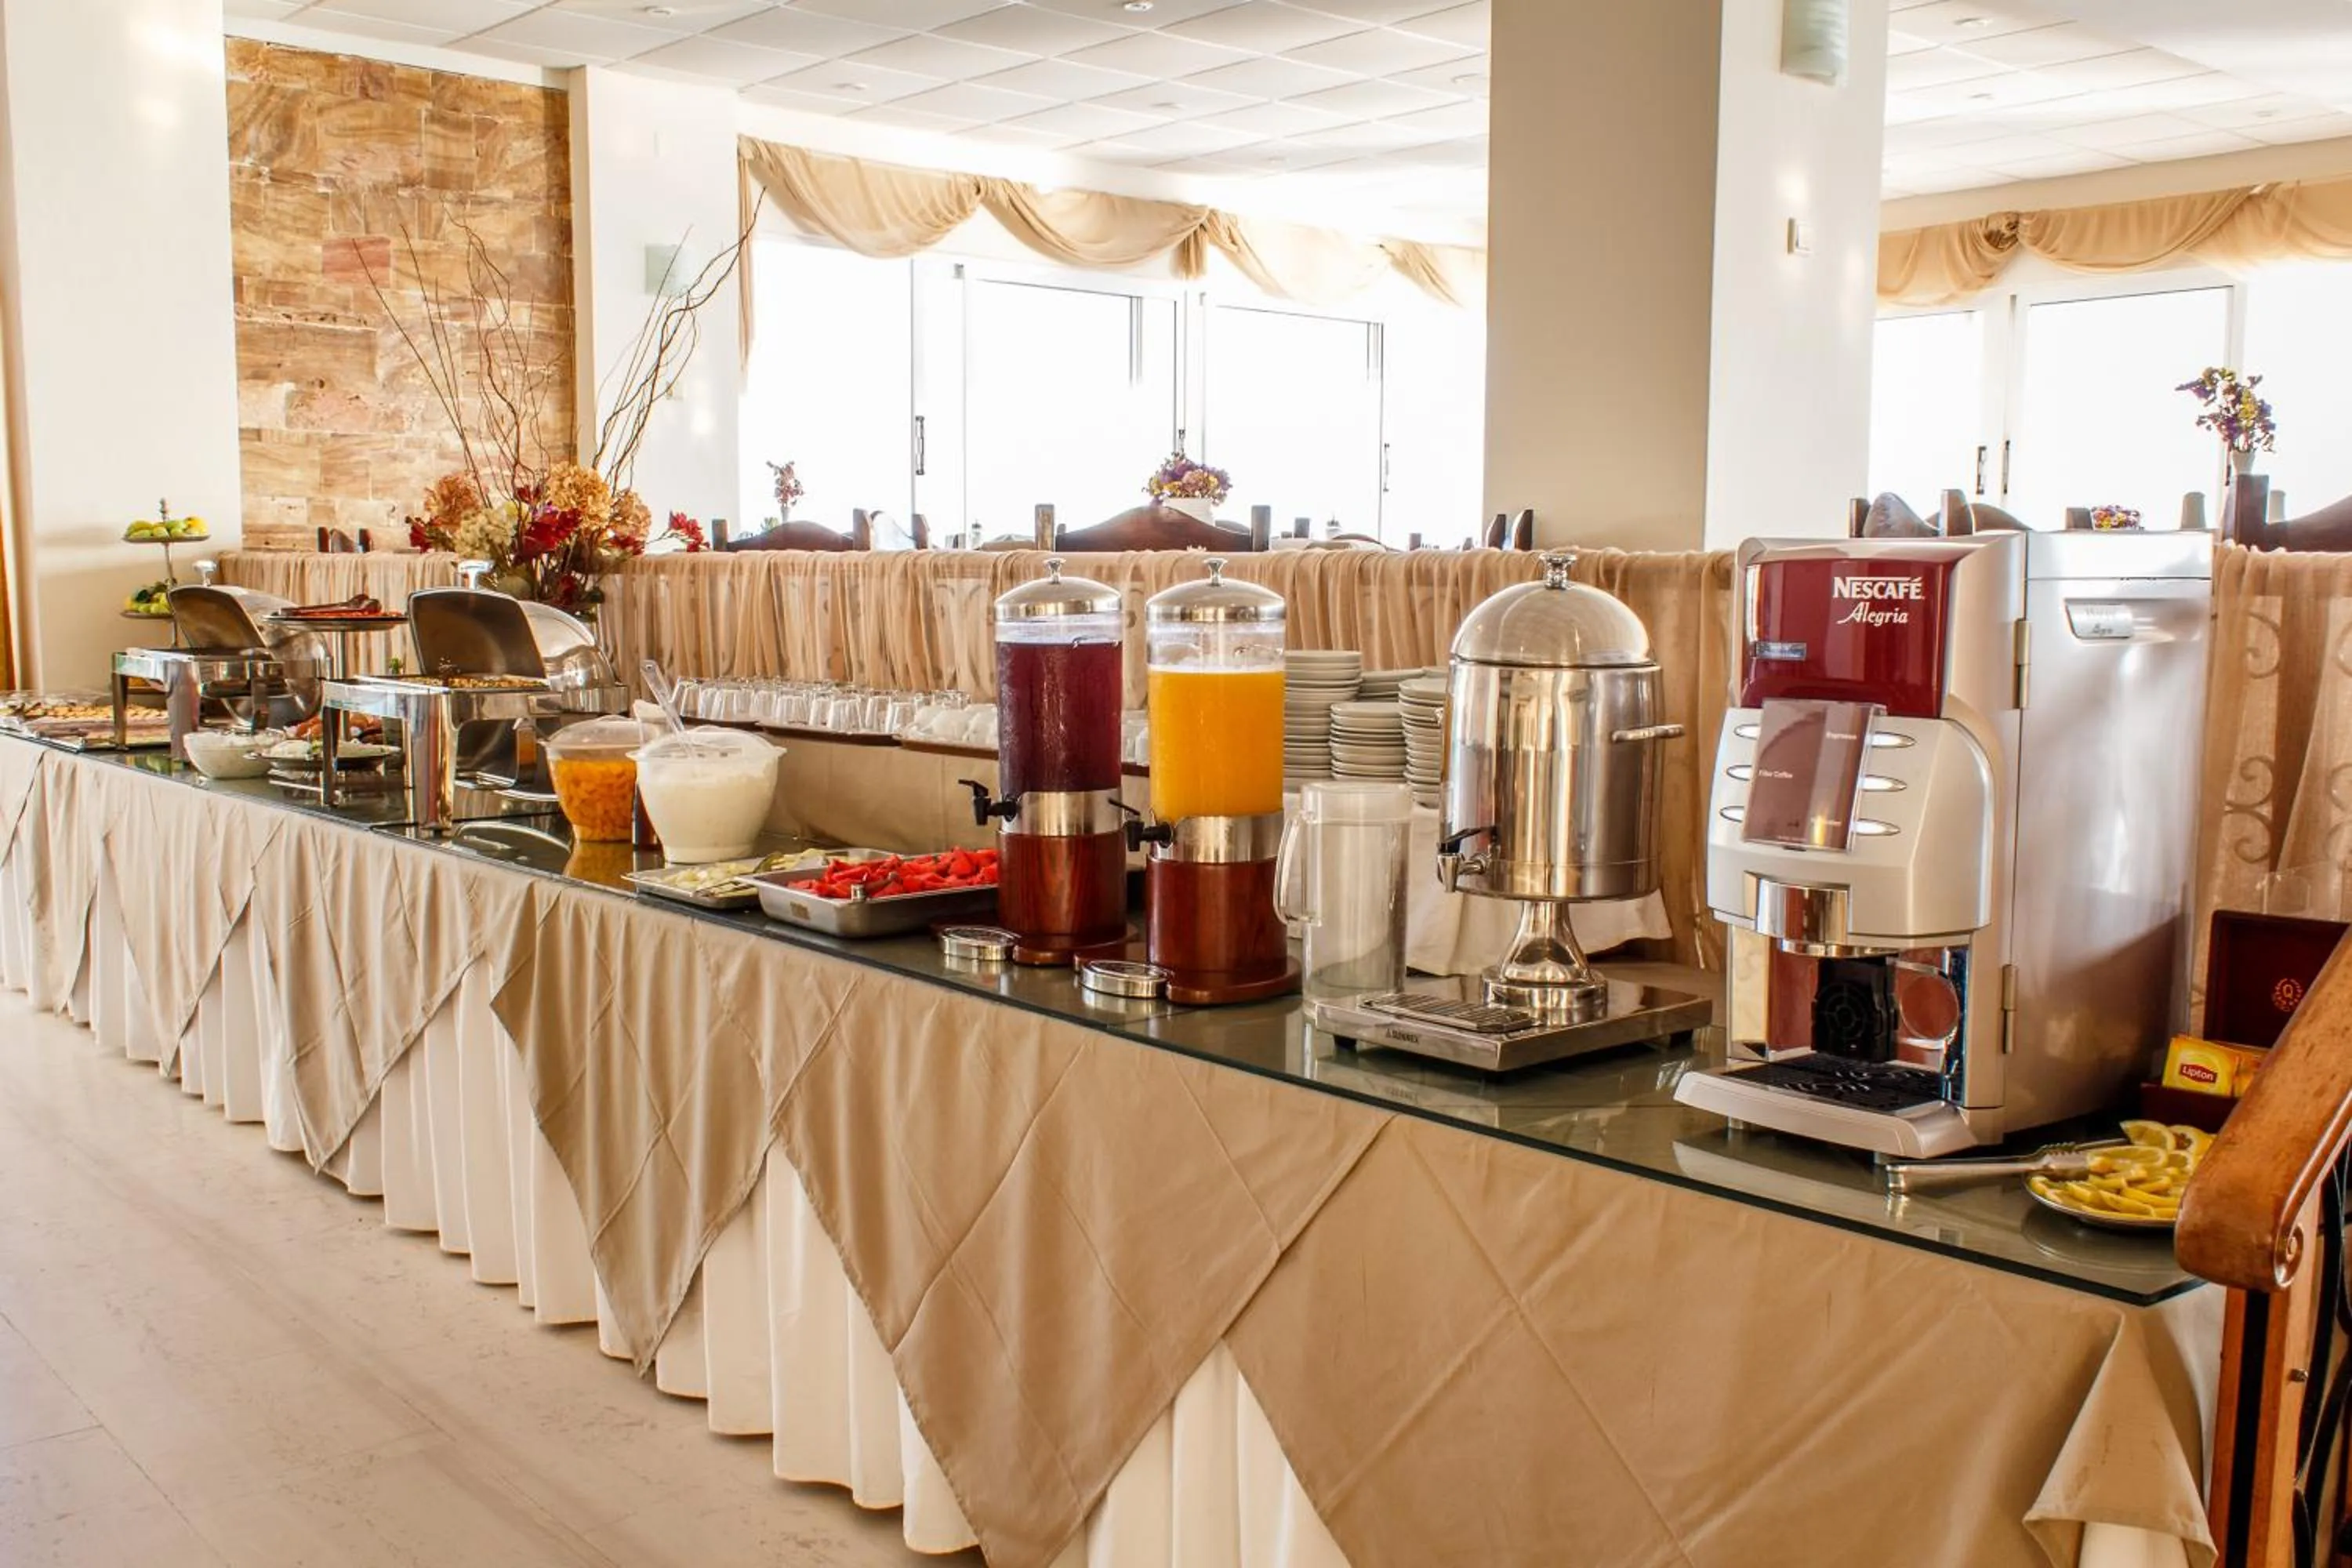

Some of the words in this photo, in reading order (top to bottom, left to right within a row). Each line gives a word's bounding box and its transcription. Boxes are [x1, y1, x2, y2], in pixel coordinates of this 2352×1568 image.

[1833, 576, 1923, 599] NESCAFÉ
[1836, 601, 1908, 627] Alegria
[2182, 1065, 2214, 1081] Lipton
